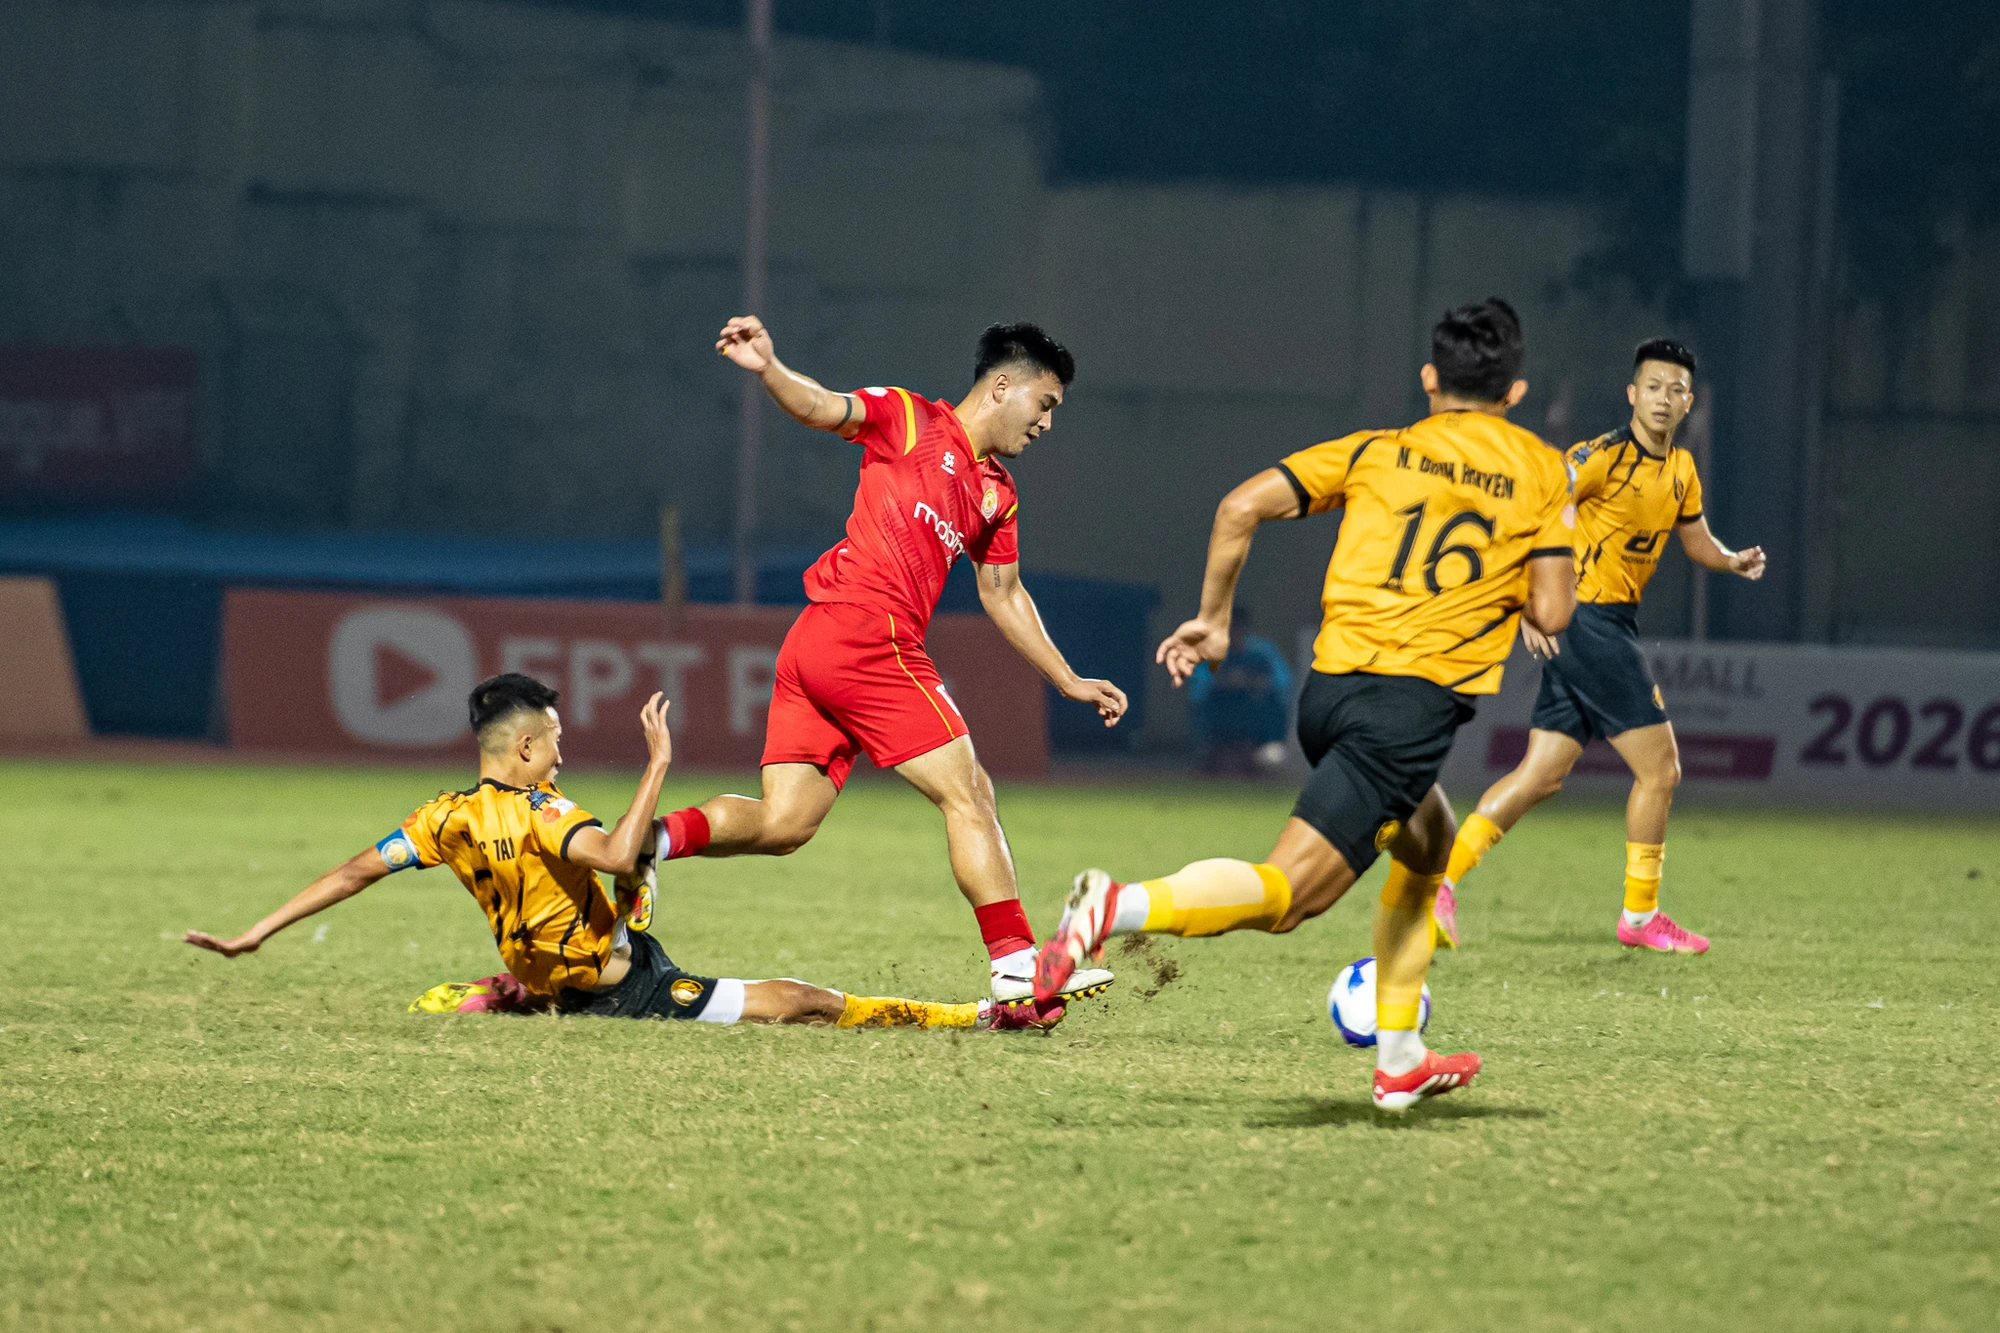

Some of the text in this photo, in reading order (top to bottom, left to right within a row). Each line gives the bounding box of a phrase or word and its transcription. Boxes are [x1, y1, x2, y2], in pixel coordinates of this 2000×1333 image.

[1397, 446, 1411, 469] N.
[1378, 497, 1496, 599] 16
[502, 637, 702, 734] FPT
[1652, 656, 1763, 698] MALL
[1801, 692, 2000, 772] 2026
